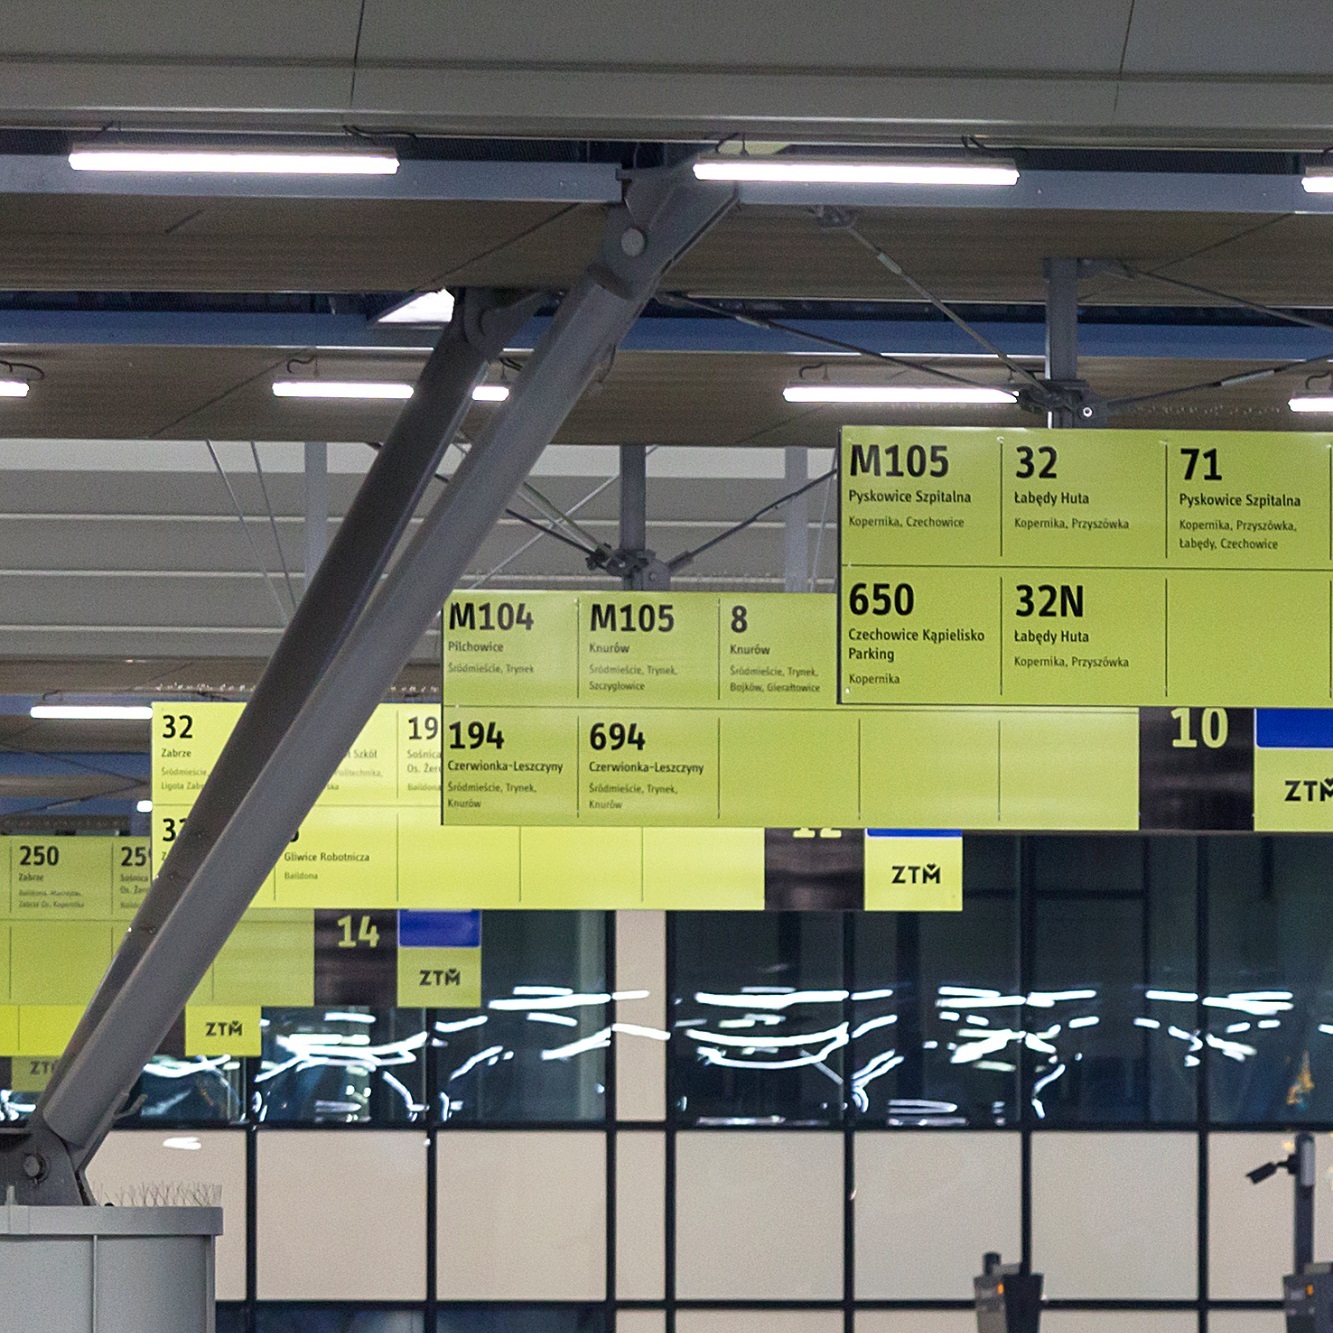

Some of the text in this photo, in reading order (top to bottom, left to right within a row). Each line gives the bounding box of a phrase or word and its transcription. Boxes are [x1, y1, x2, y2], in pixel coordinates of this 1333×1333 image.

[850, 444, 949, 478] M105
[1016, 445, 1058, 479] 32
[1180, 448, 1222, 481] 71
[849, 489, 972, 505] Pyskowice Szpitalna
[1014, 491, 1089, 507] Łabędy Huta
[1179, 493, 1301, 509] Pyskowice Szpitalna
[849, 516, 965, 529] Kopernika, Czechowice
[1014, 517, 1129, 530] Kopernika, Przyszówka
[1179, 519, 1297, 533] Kopernika, Przyszówka,
[1179, 537, 1278, 551] Łabędy, Czechowice
[850, 583, 914, 616] 650
[1016, 584, 1084, 617] 32N
[449, 602, 534, 631] M104
[590, 604, 675, 632] M105
[731, 605, 748, 633] 8
[848, 628, 985, 644] Czechowice Kąpielisko
[1014, 629, 1089, 645] Łabędy Huta
[448, 641, 504, 652] Pilchowice
[589, 642, 630, 653] Knurów
[730, 644, 770, 655] Knurów
[848, 647, 894, 663] Parking
[1014, 656, 1129, 669] Kopernika, Przyszówka
[506, 663, 534, 675] Trynek
[849, 673, 900, 685] Kopernika
[162, 715, 193, 739] 32
[1171, 707, 1229, 748] 10
[449, 721, 505, 750] 194
[590, 722, 646, 751] 694
[161, 748, 191, 758] Zabrze
[424, 763, 440, 773] Żer
[447, 760, 563, 774] Czerwionka-Leszczyny
[589, 761, 704, 775] Czerwionka-Leszczyny
[447, 798, 481, 808] Knurów
[19, 845, 59, 866] 250
[121, 846, 150, 867] 25
[284, 851, 370, 862] Gliwice Robotnicza
[892, 864, 941, 884] ZTM
[336, 915, 380, 949] 14
[419, 968, 461, 986] ZTM
[205, 1021, 243, 1036] ZTM
